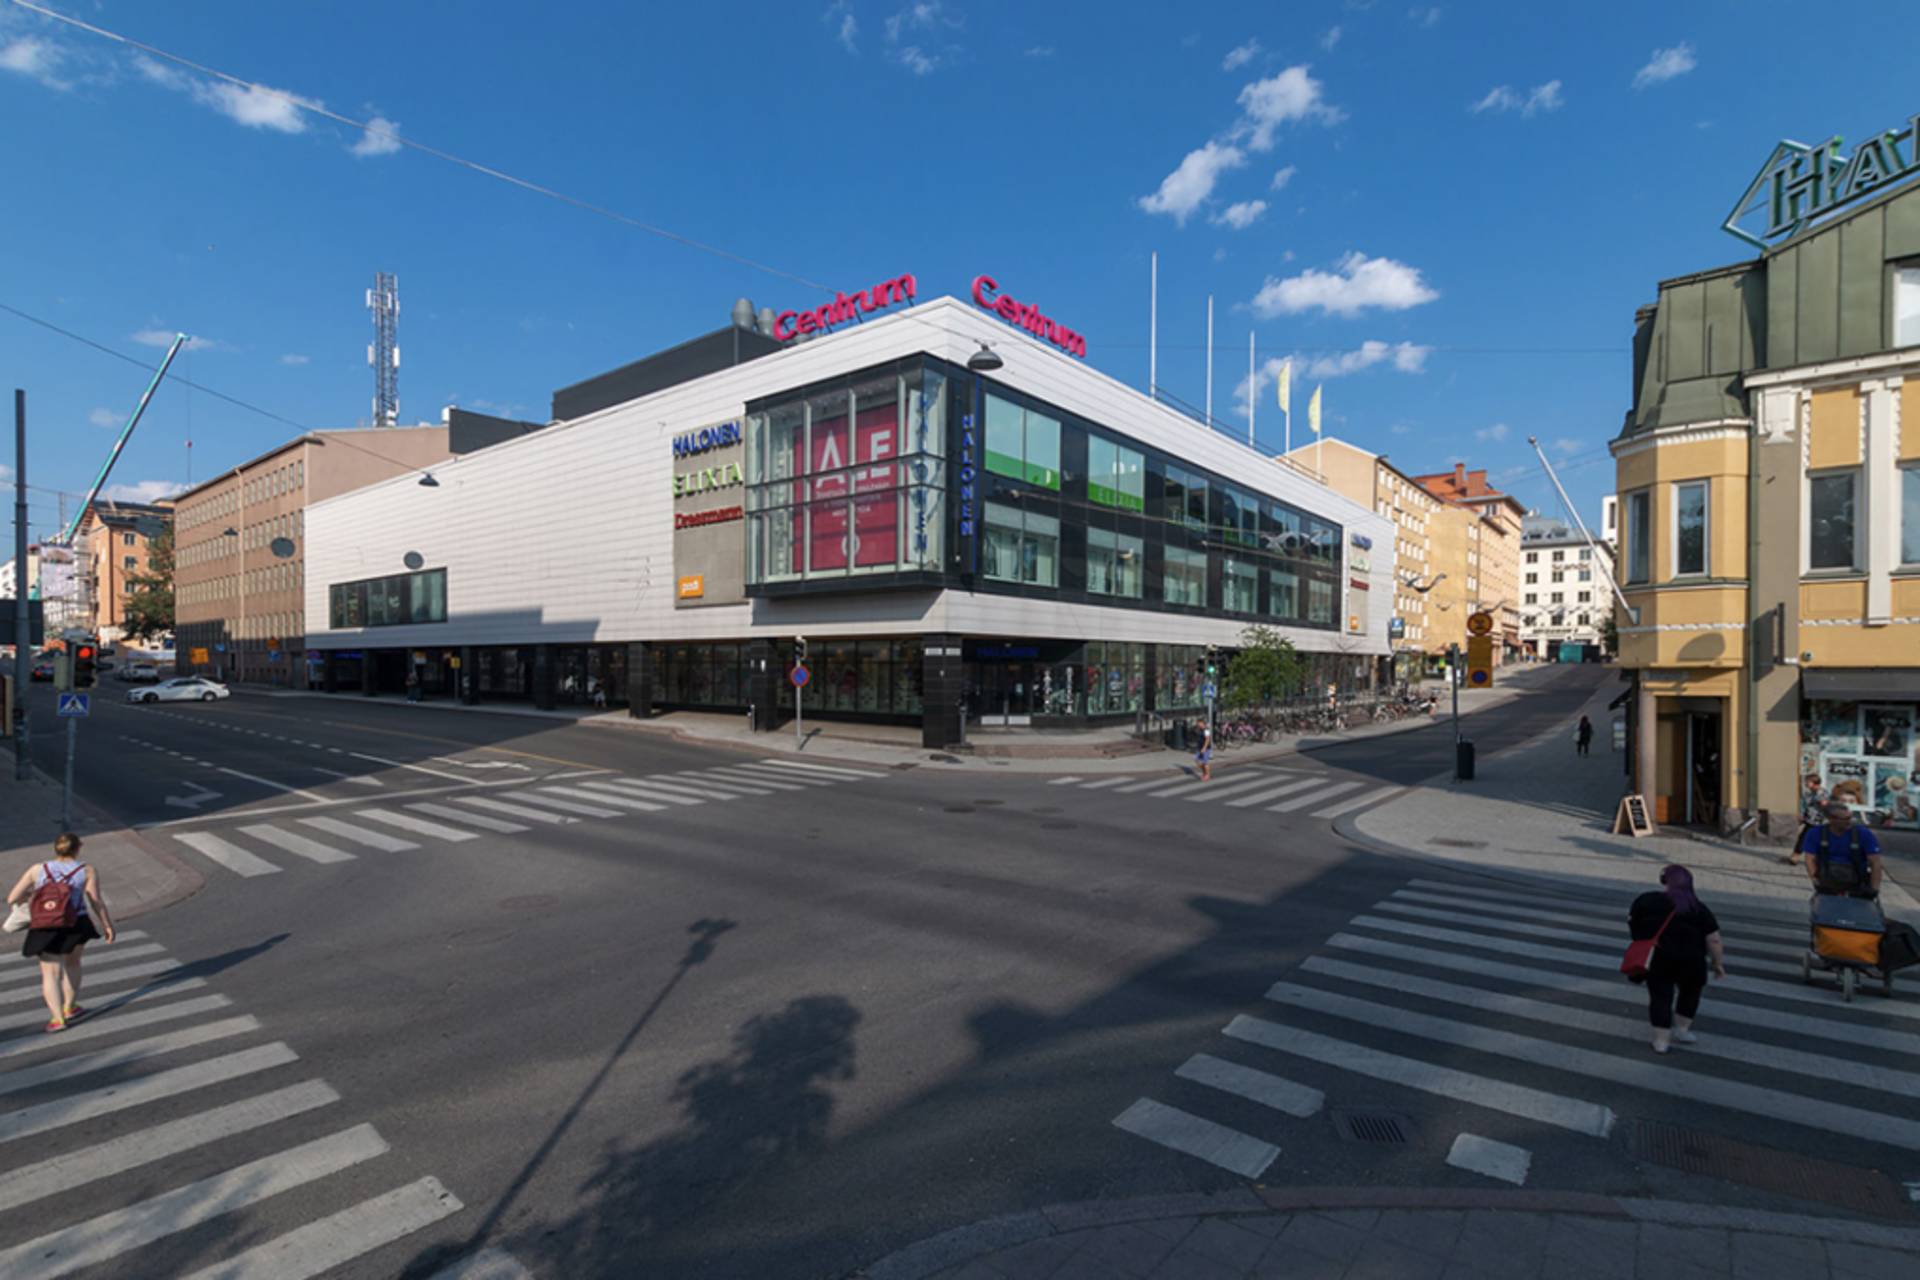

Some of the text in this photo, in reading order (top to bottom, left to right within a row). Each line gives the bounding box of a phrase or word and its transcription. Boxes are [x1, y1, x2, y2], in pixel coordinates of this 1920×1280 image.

[773, 273, 916, 341] Centrum
[972, 275, 1086, 357] Centrum
[673, 421, 741, 457] HALONEN
[961, 414, 975, 535] HALONEN
